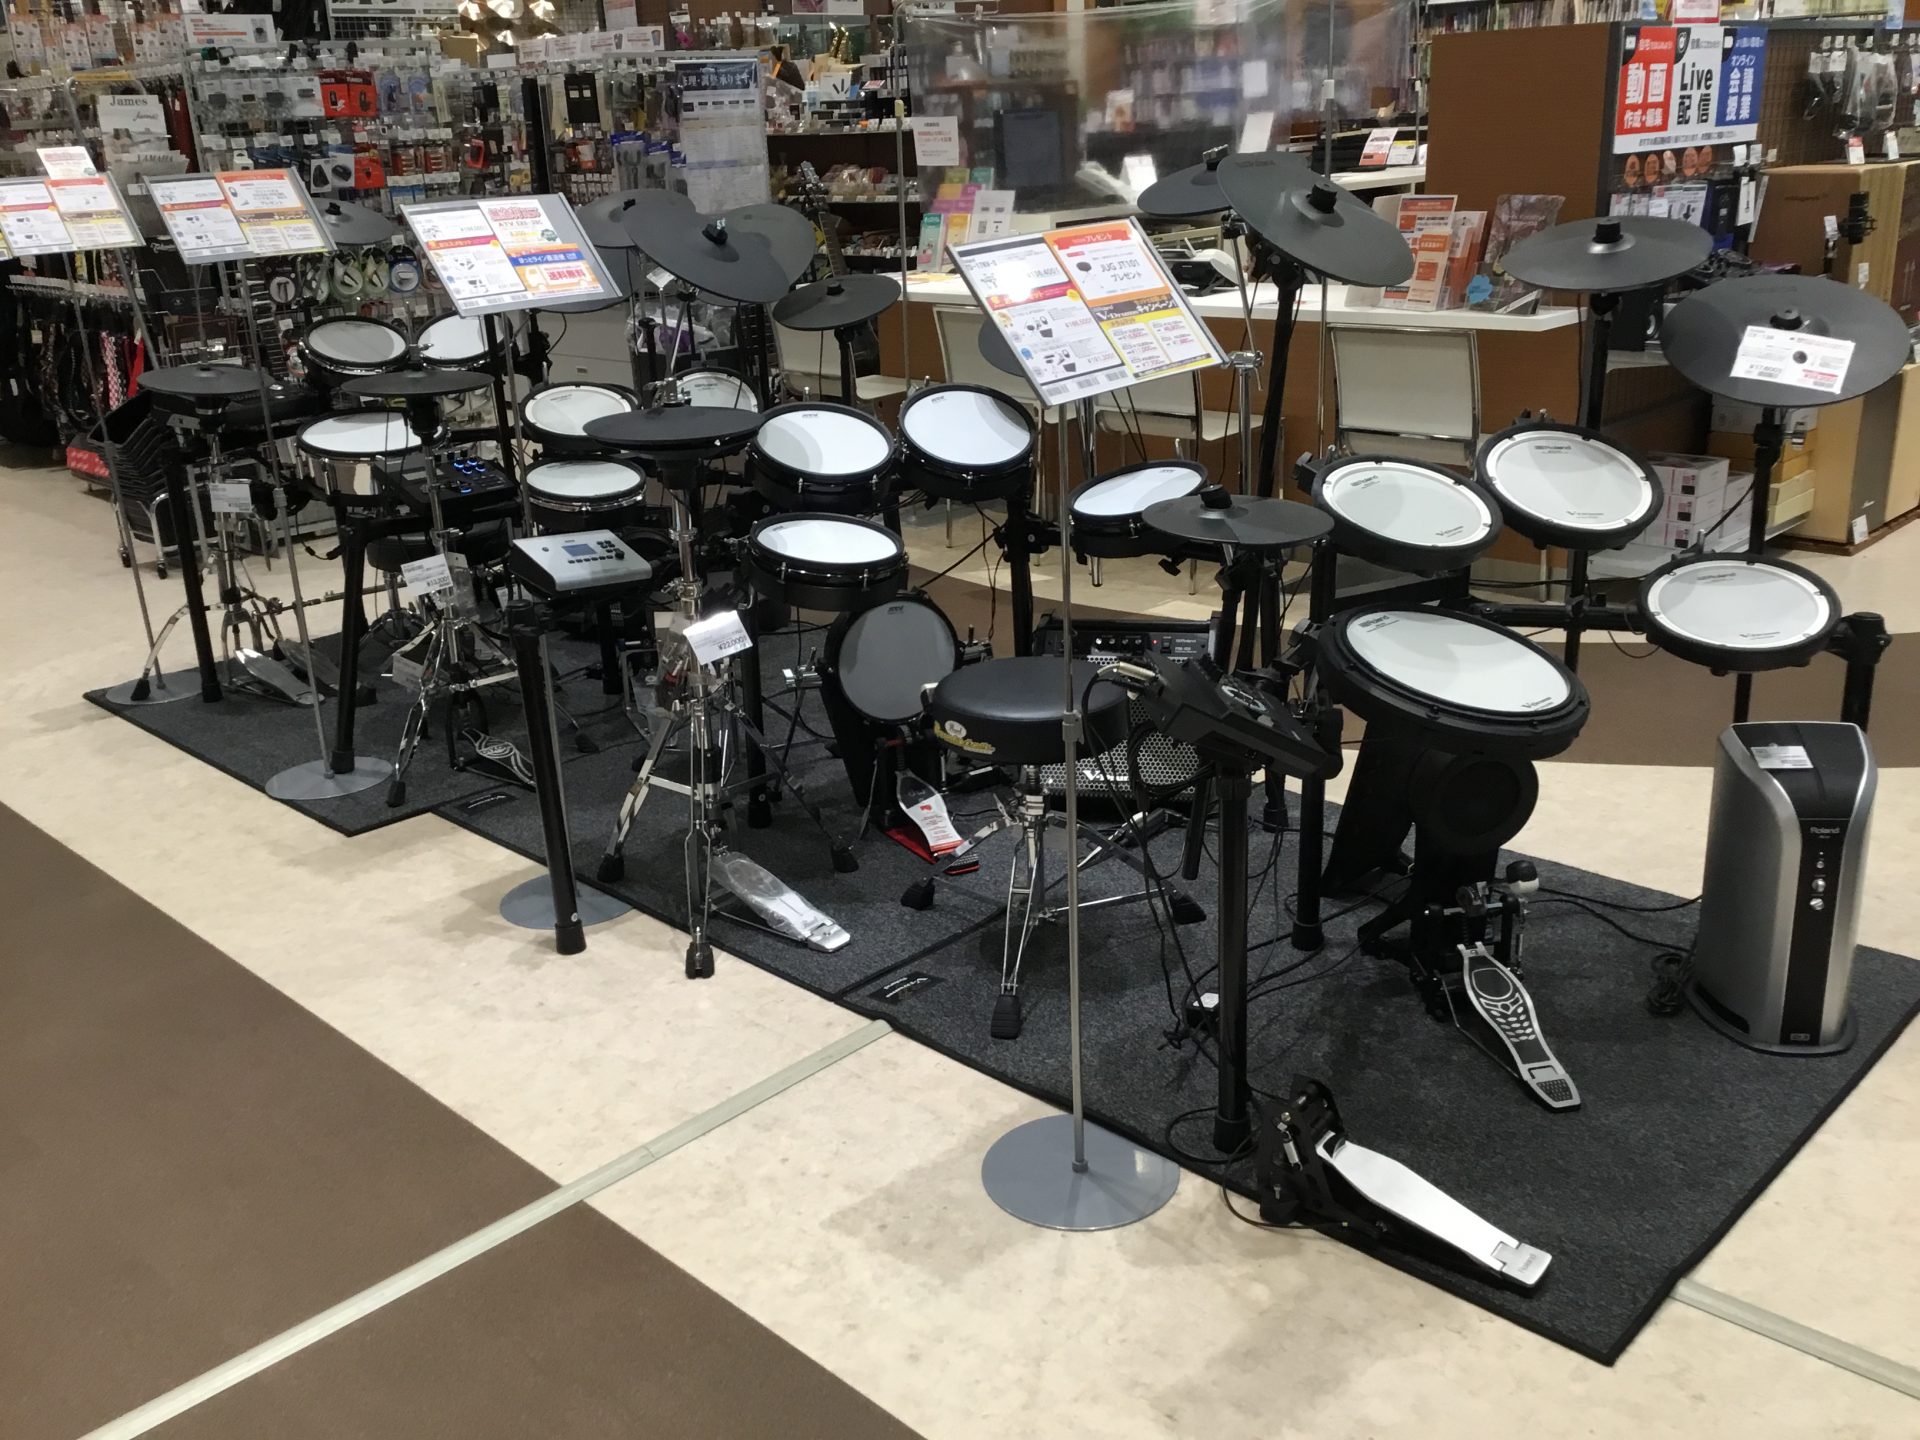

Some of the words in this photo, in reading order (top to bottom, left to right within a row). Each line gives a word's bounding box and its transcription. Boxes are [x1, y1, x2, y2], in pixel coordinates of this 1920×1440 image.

[1731, 54, 1756, 67] オンライン
[1625, 62, 1668, 105] 動画
[1680, 62, 1713, 91] Live
[1728, 68, 1754, 93] 会議
[110, 95, 148, 106] James
[1677, 93, 1711, 125] 配信
[1725, 95, 1751, 121] 授業
[1624, 108, 1663, 129] 作成・編集
[548, 269, 586, 281] 送料無料
[1101, 262, 1117, 273] JUG
[1110, 271, 1142, 282] プレゼント
[1809, 826, 1840, 834] Roland
